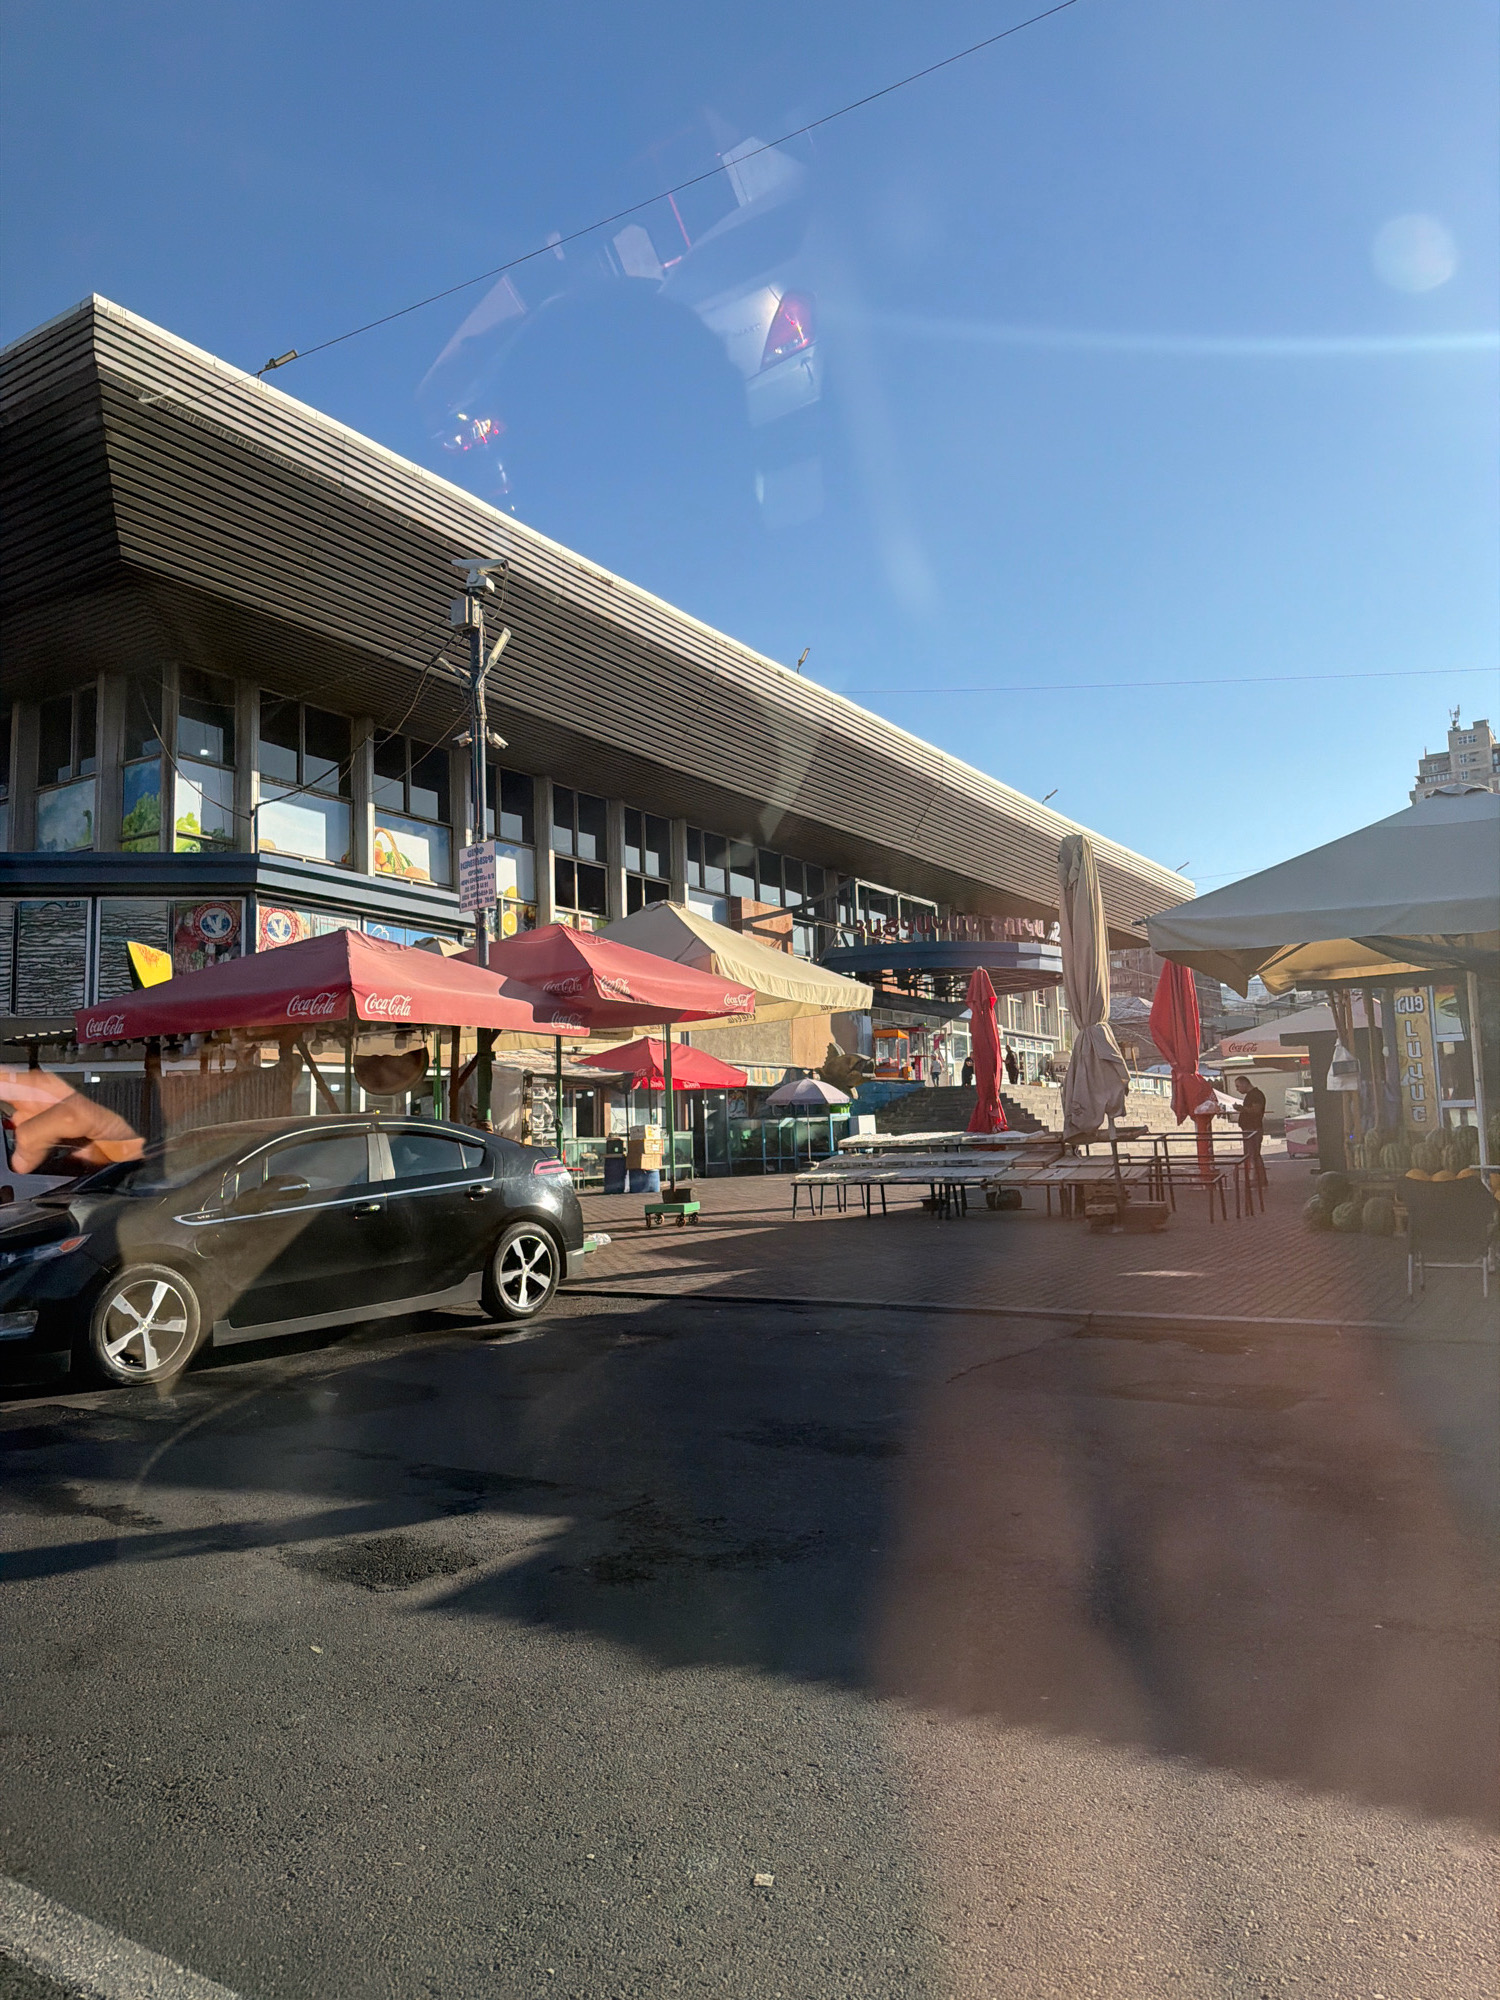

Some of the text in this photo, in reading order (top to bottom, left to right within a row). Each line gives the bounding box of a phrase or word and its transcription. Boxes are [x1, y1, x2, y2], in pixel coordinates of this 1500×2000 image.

[287, 992, 335, 1017] Coca-Cola
[363, 992, 413, 1017] Coca-Cola
[85, 1014, 125, 1038] Coca-Cola
